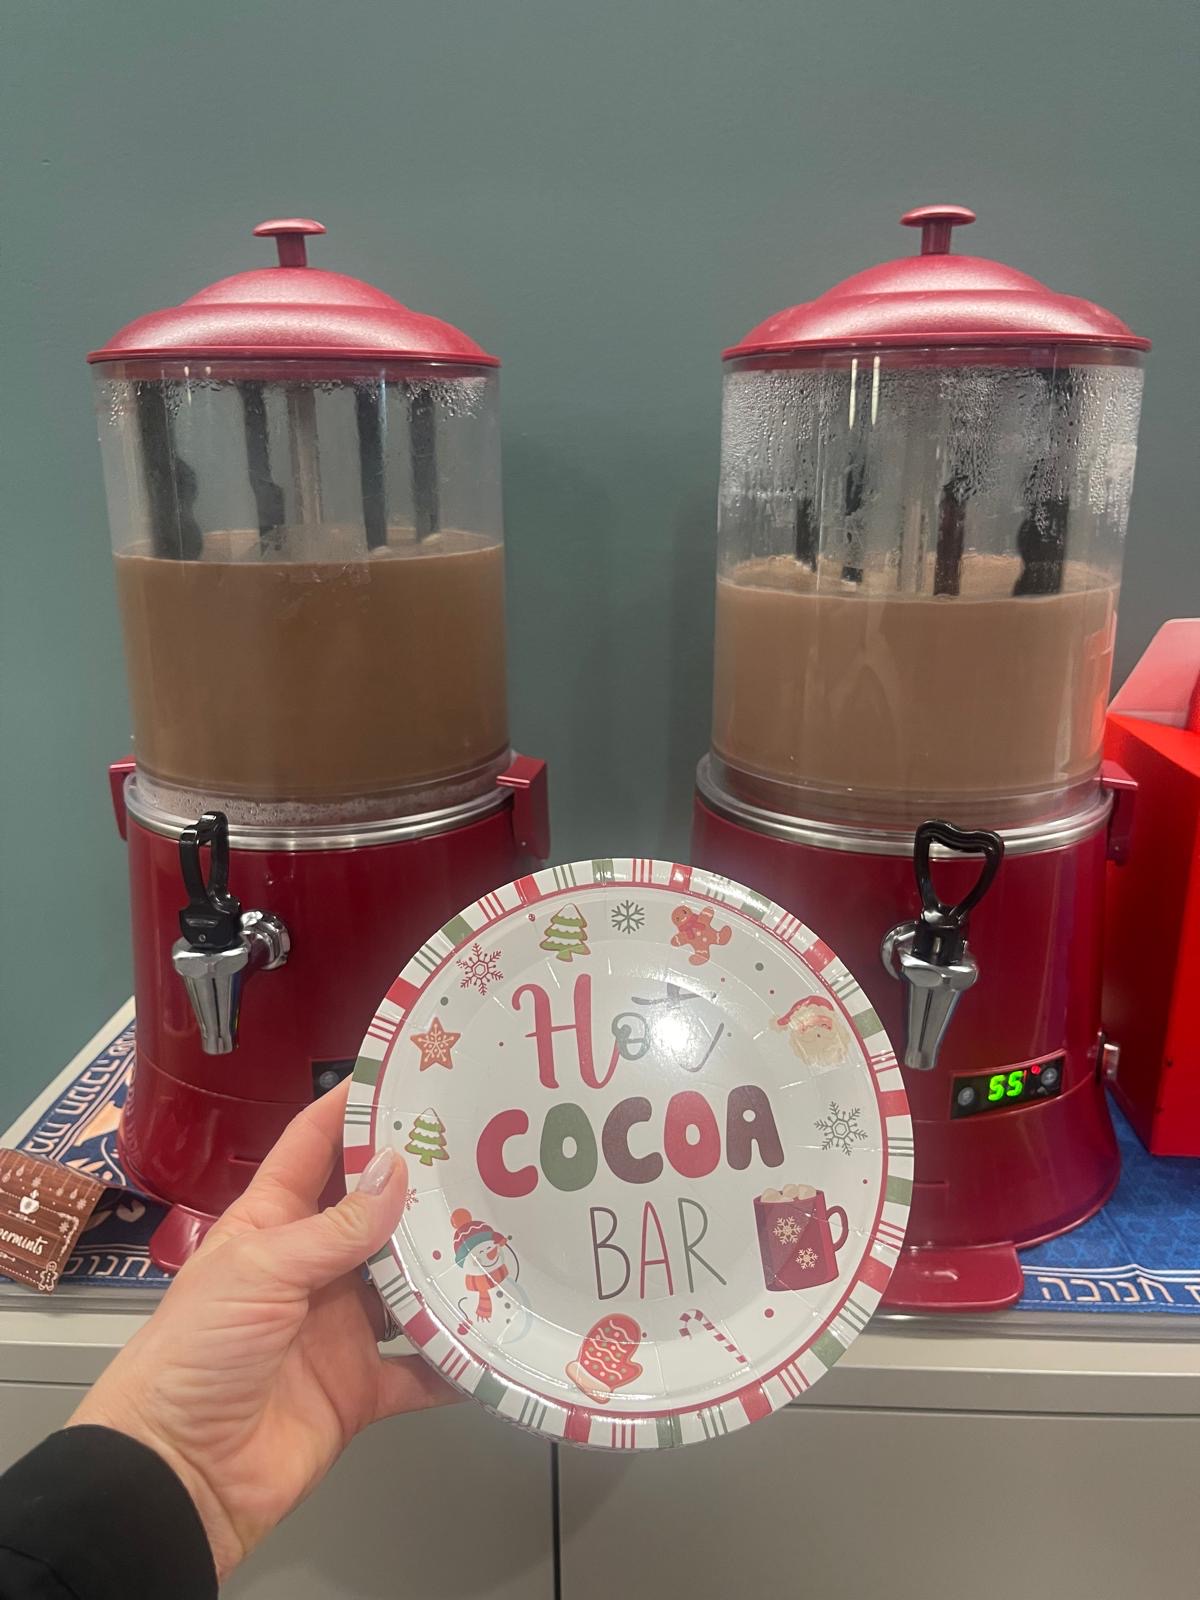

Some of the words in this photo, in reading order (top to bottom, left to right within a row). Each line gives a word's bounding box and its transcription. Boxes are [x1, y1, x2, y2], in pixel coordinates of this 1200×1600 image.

[512, 973, 725, 1090] Hot
[988, 1070, 1024, 1101] 55
[476, 1085, 785, 1198] COCOA
[62, 1255, 152, 1278] חנוכ
[589, 1197, 727, 1300] BAR
[1037, 1276, 1175, 1303] חנוכה
